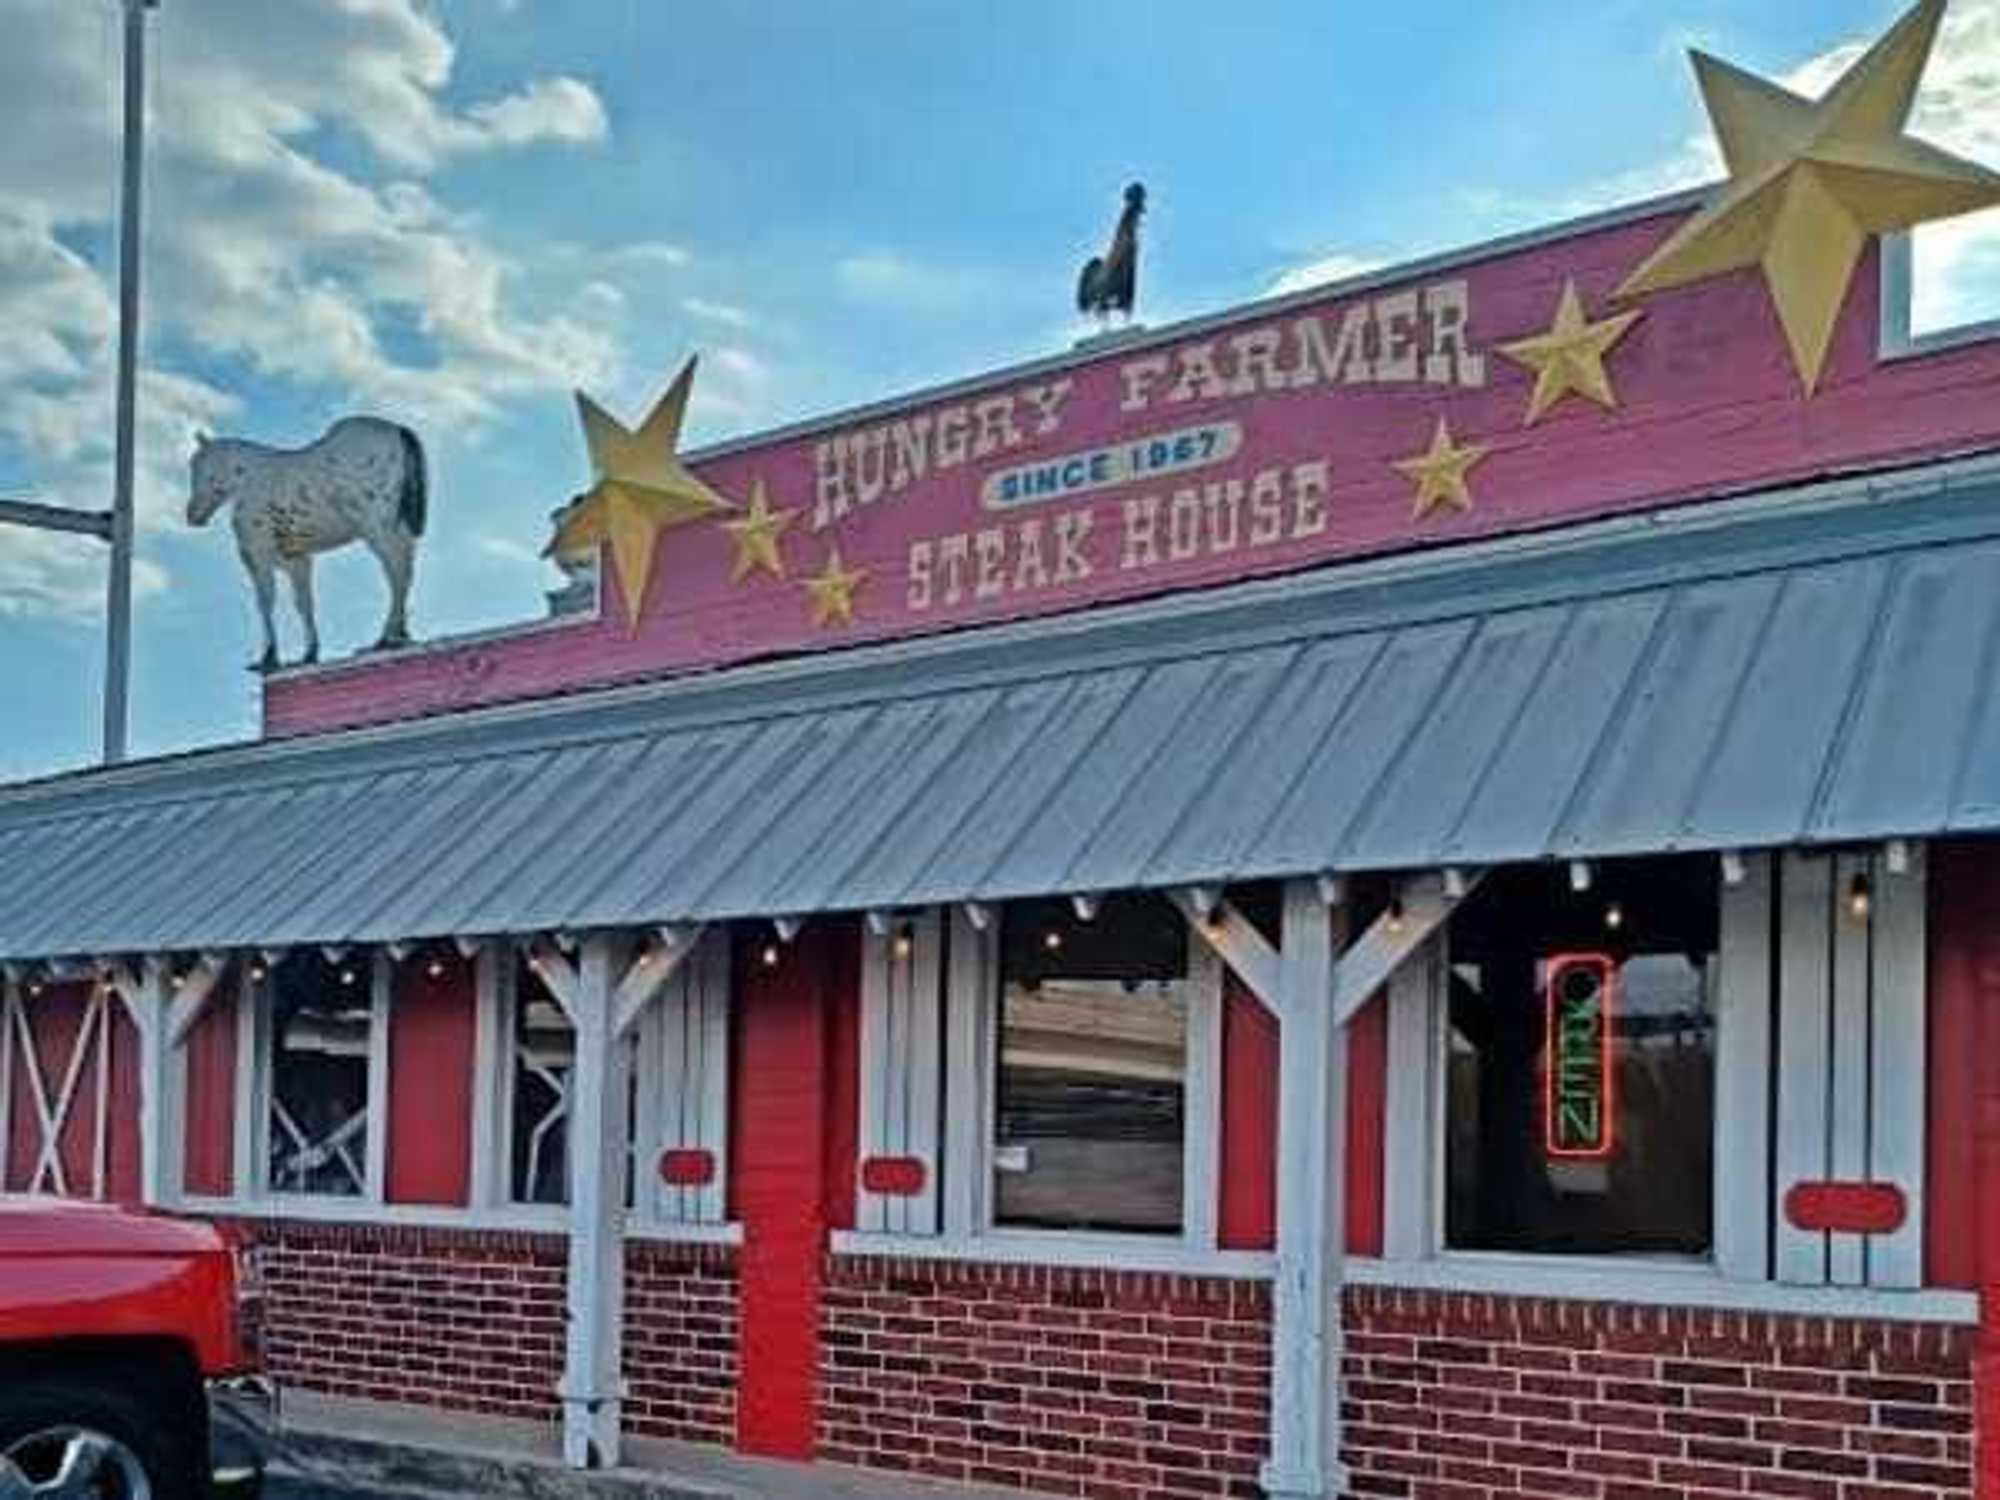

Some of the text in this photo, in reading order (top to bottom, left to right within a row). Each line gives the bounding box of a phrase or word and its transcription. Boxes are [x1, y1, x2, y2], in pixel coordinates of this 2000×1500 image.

[813, 281, 1485, 529] HUNGRY FARMER
[1001, 453, 1109, 500] SINCE
[906, 463, 1329, 609] STEAK HOUSE
